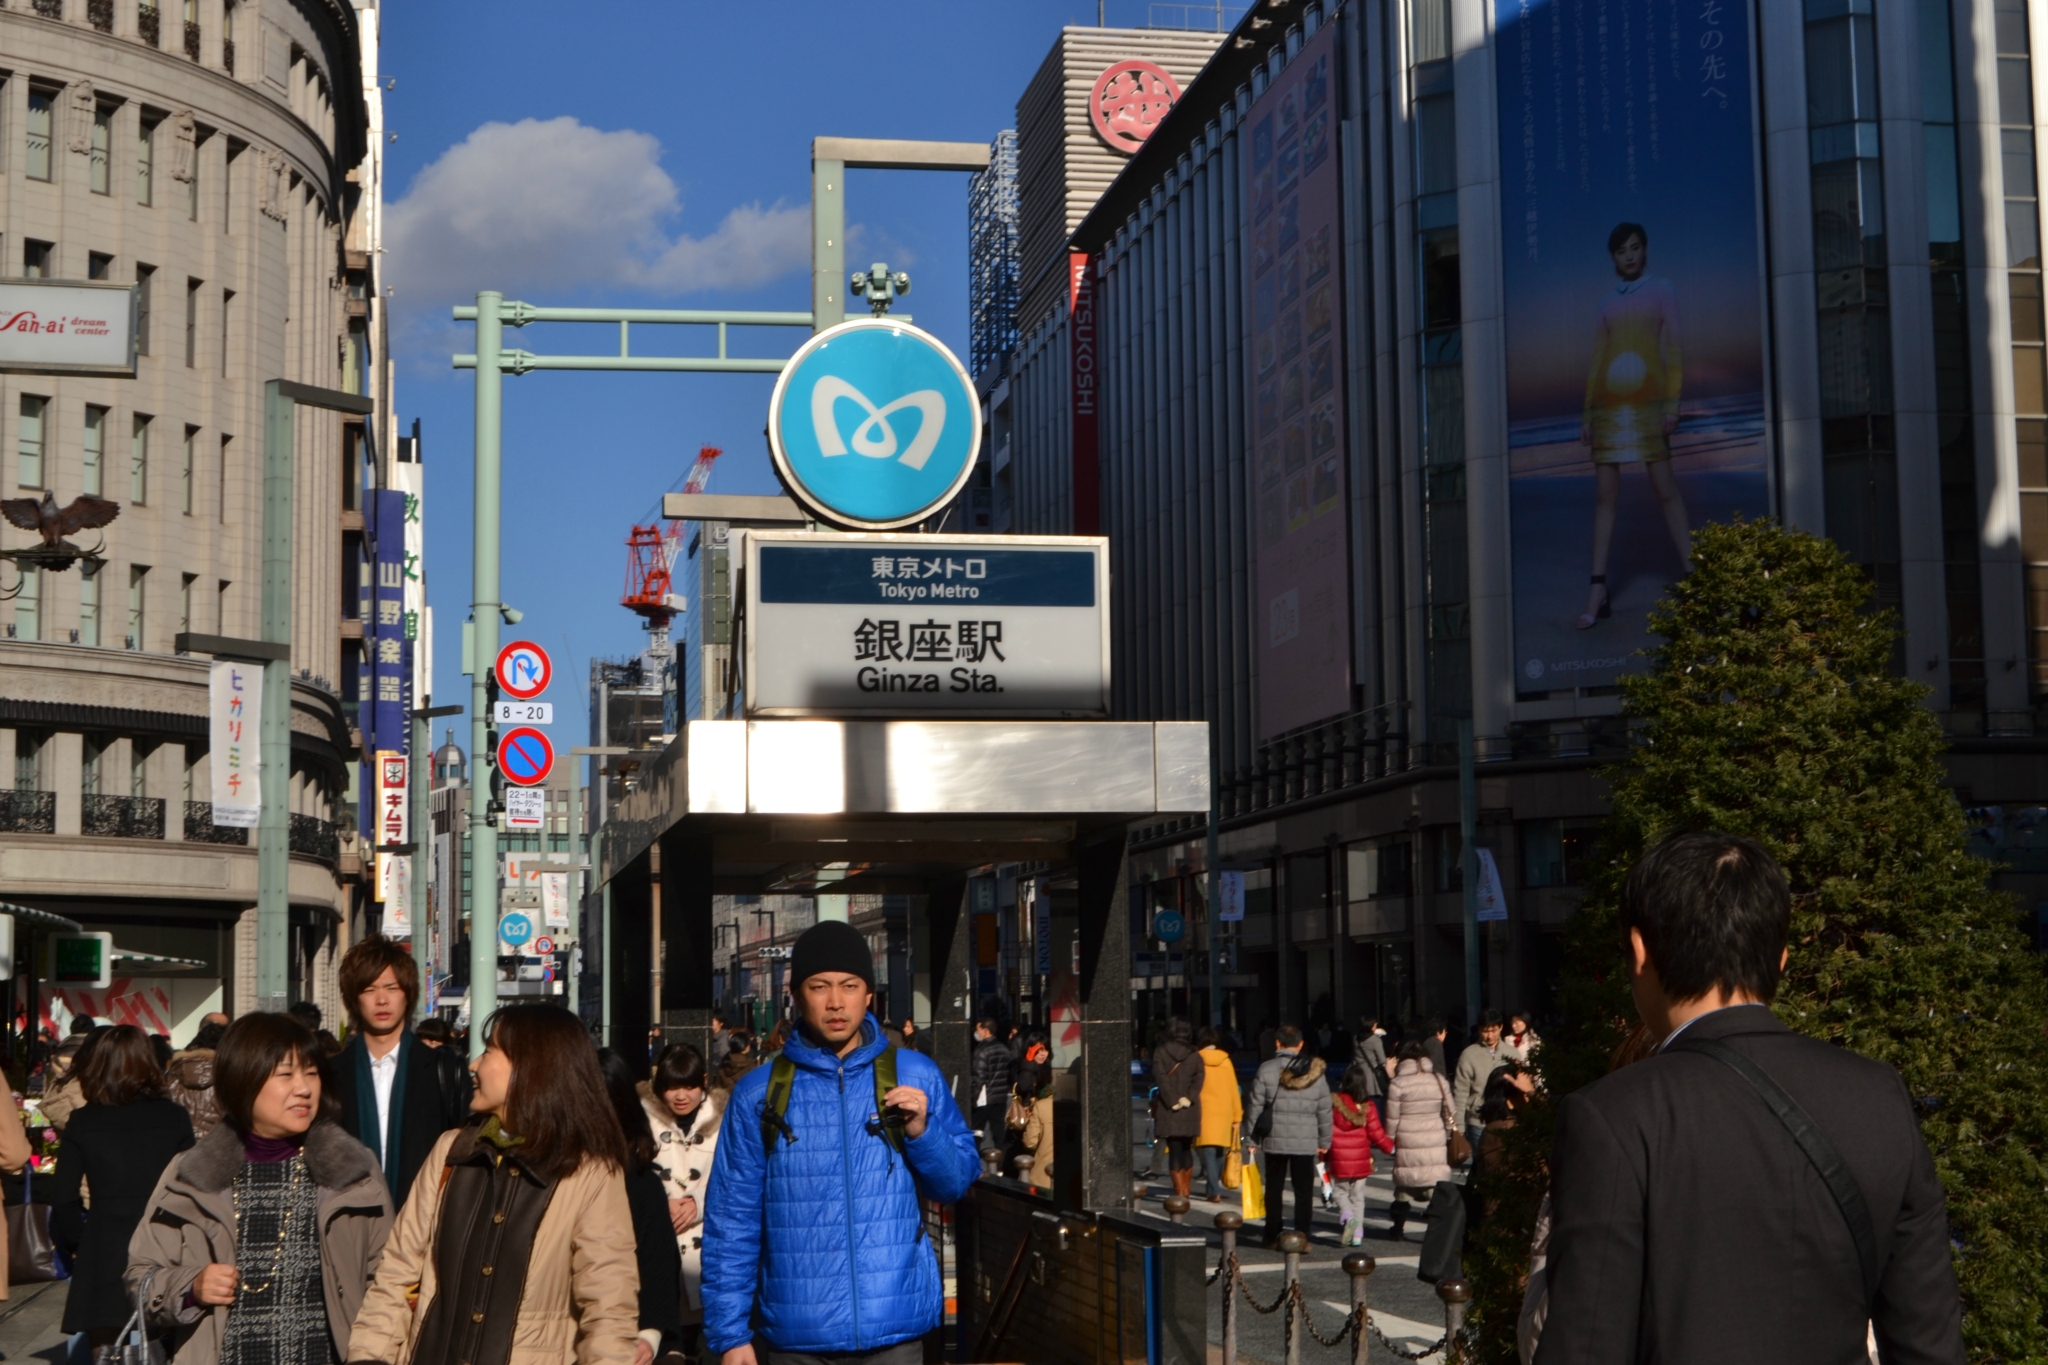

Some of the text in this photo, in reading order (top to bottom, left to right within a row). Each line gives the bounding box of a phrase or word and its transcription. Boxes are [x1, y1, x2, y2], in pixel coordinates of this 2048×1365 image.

[1698, 0, 1728, 109] その先へ。
[70, 316, 107, 327] dream
[74, 327, 110, 336] center
[1074, 265, 1094, 415] MITSUKOSHI
[871, 556, 987, 580] 東京メトロ
[878, 582, 980, 601] Tokyo Metro
[378, 561, 402, 702] 山野楽器
[853, 617, 1006, 664] 銀座駅
[1550, 656, 1627, 673] MITSUKOSHI
[856, 666, 1005, 694] Ginza Sta.
[227, 668, 244, 797] ヒカリミチ
